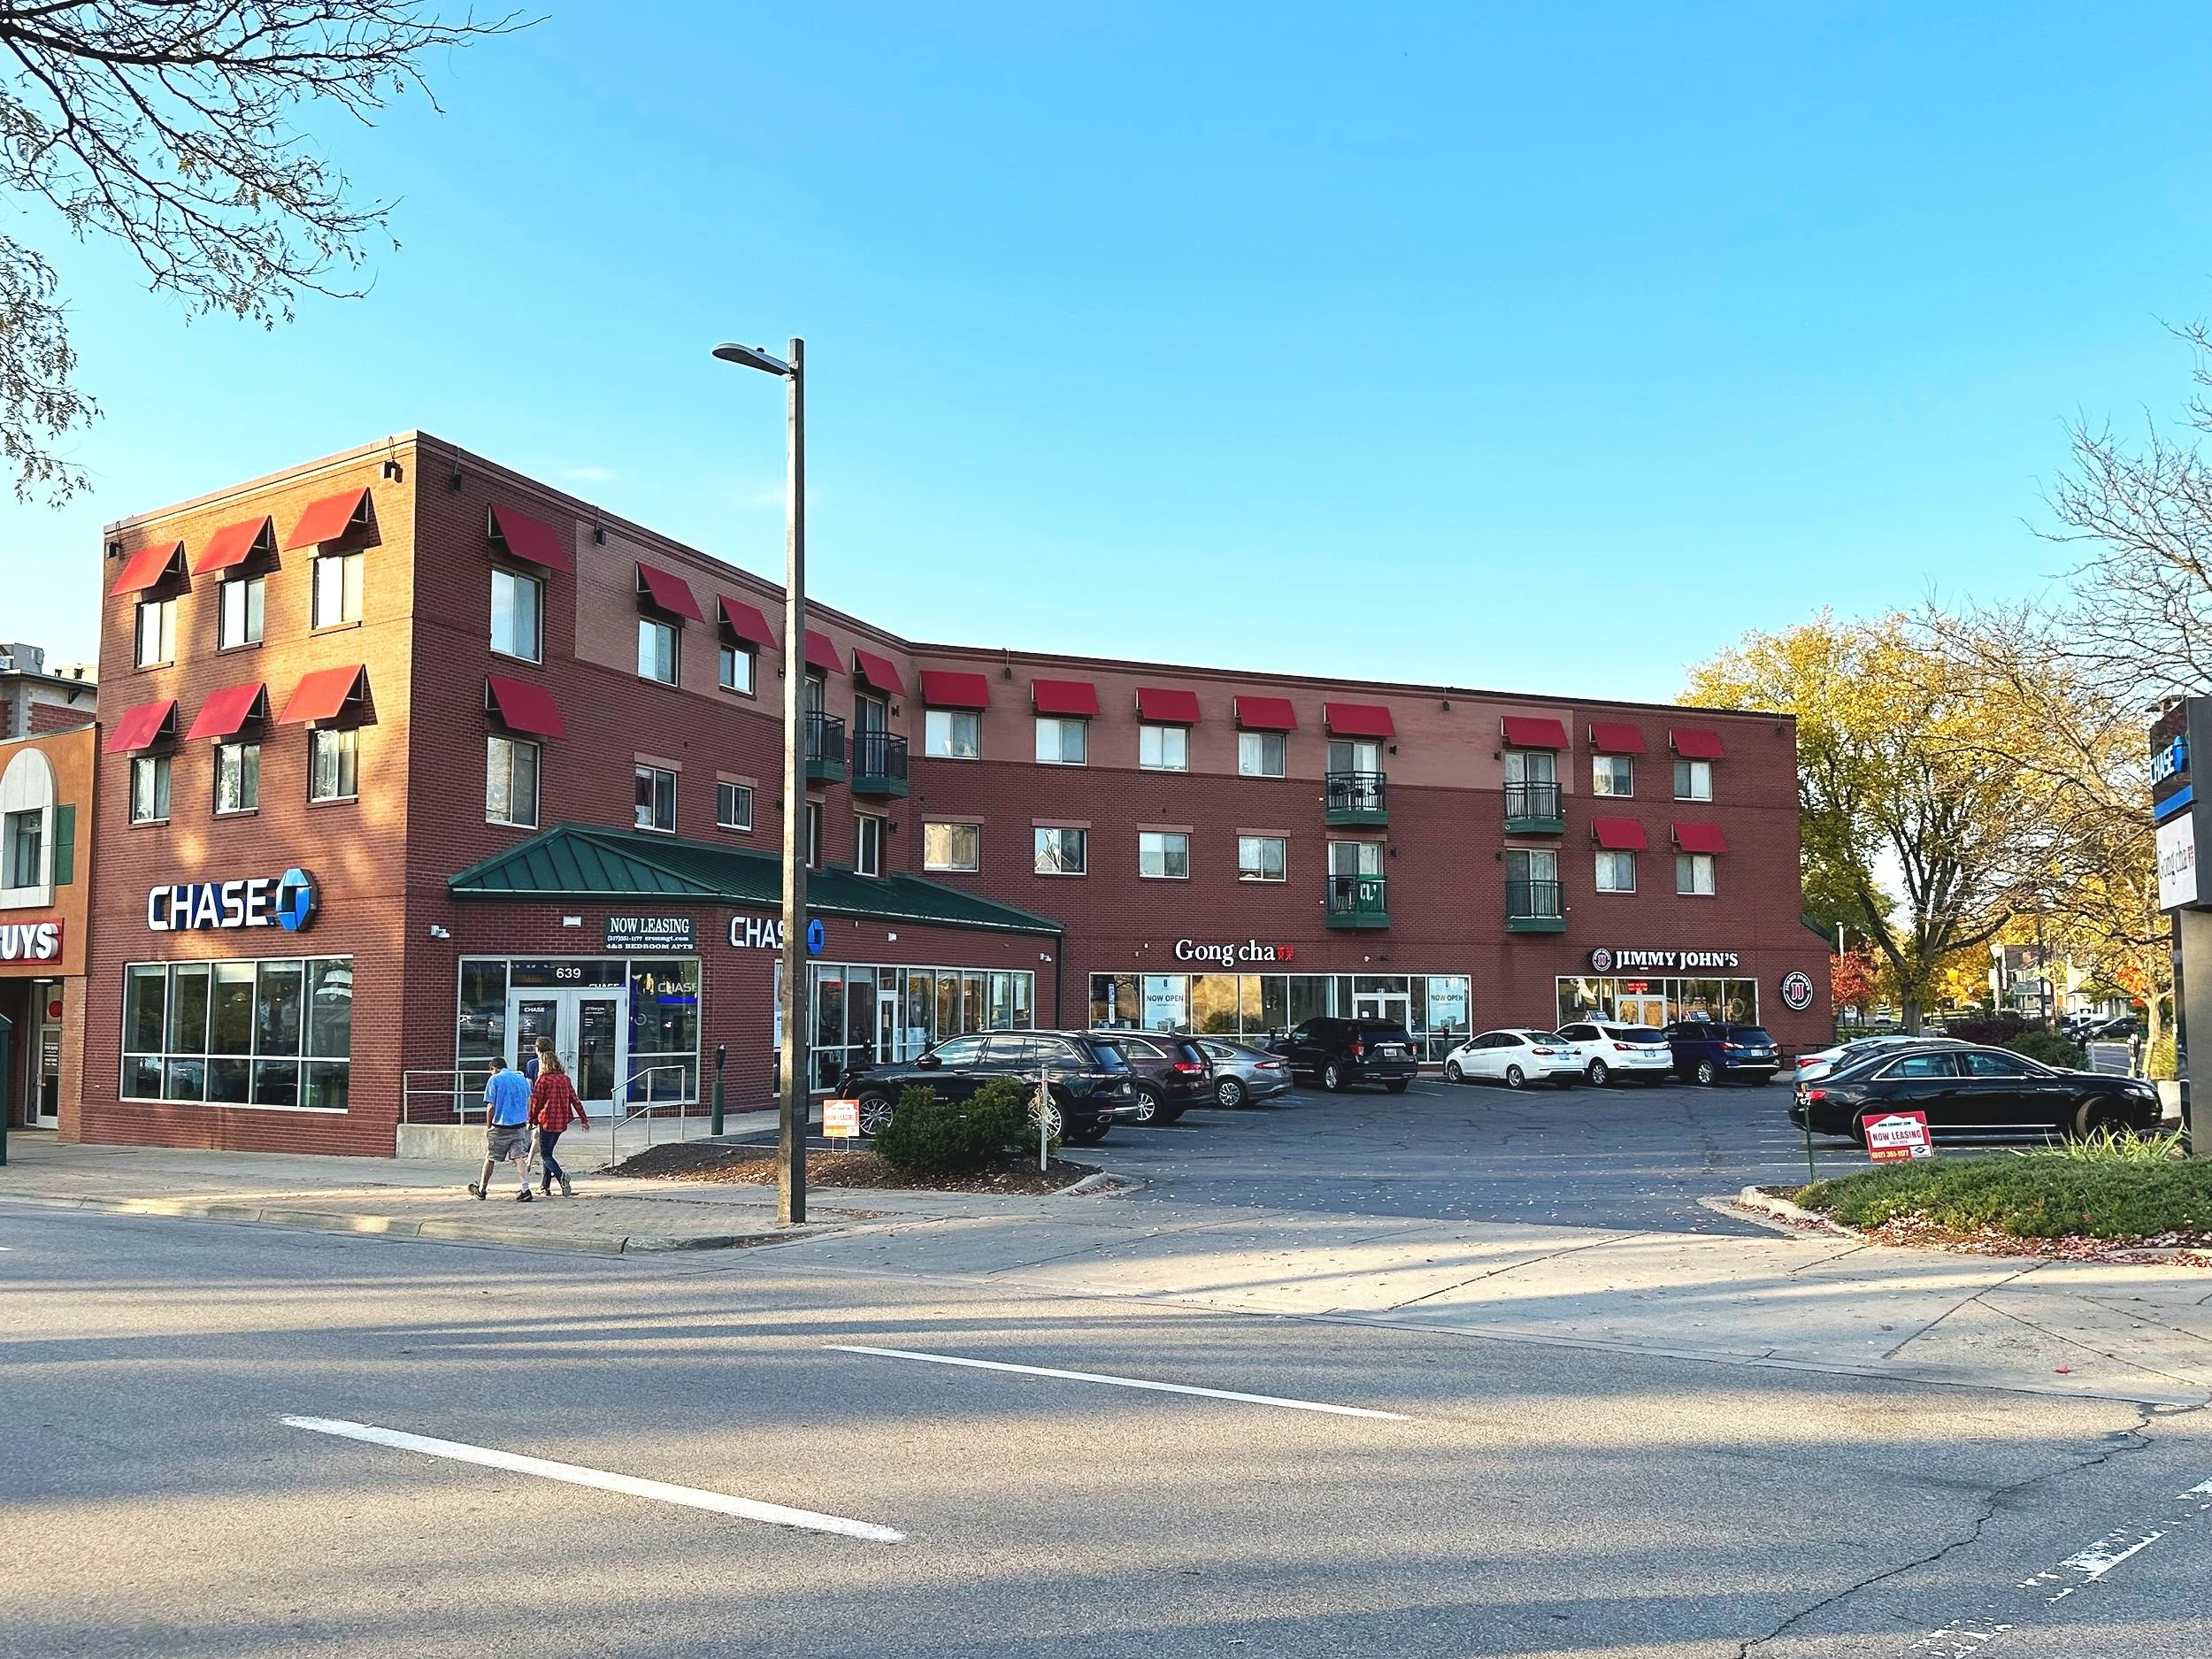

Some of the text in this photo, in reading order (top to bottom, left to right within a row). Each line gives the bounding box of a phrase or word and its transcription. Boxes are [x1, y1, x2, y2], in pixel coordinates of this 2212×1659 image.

[2150, 745, 2174, 786] CHASE
[148, 879, 269, 931] CHASE
[610, 918, 690, 933] NOW LEASING
[731, 916, 783, 949] CHA
[0, 923, 55, 960] UYS
[1175, 939, 1276, 967] Gong cha
[556, 967, 581, 979] 639
[1616, 951, 1676, 970] JIMMY
[1679, 952, 1739, 971] JOHN'S
[1791, 982, 1805, 1000] JJ
[1872, 1130, 1922, 1141] NOW LEASING
